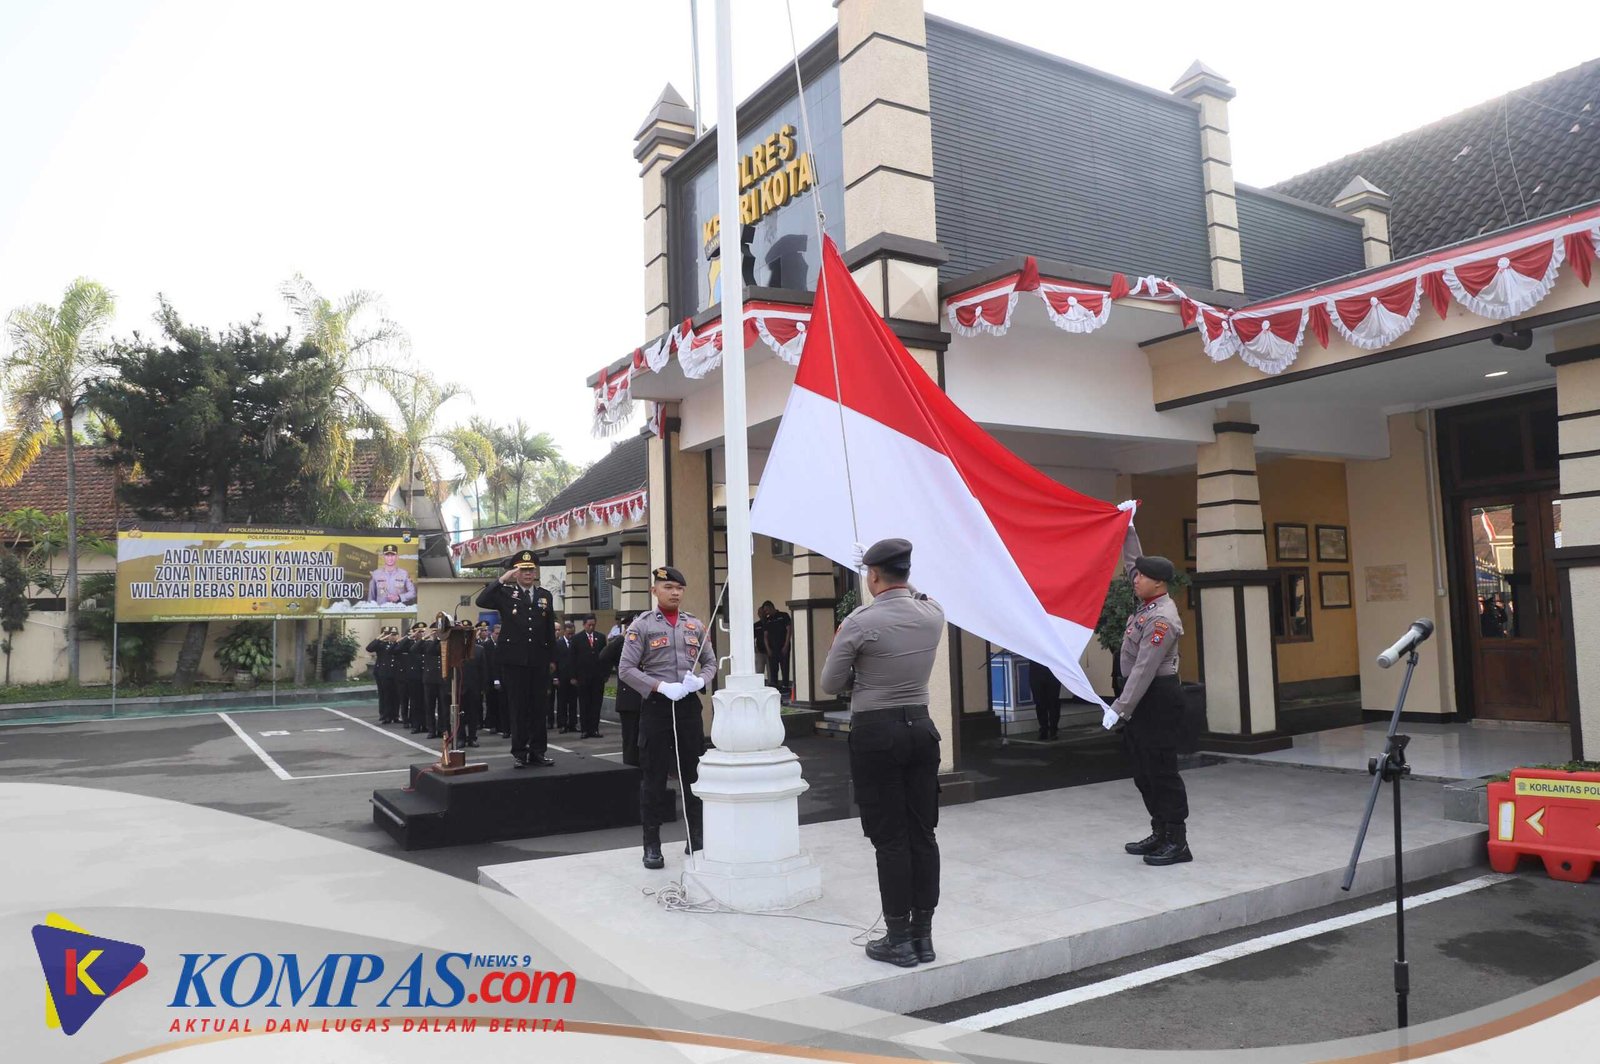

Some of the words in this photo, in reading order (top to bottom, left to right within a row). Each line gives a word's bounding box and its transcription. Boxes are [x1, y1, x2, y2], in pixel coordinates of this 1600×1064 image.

[738, 123, 797, 191] LRES
[761, 152, 813, 216] KOTA
[163, 549, 200, 564] ANDA
[203, 549, 271, 565] MEMASUKI
[274, 550, 334, 566] KAWASAN
[155, 565, 191, 581] ZONA
[194, 566, 267, 581] INTEGRITAS
[270, 566, 292, 582] (ZI)
[295, 567, 343, 582] MENUJU
[131, 583, 190, 598] WILAYAH
[193, 583, 235, 598] BEBAS
[238, 583, 267, 598] DARI
[271, 583, 322, 598] KORUPSI
[326, 583, 364, 599] (WBK)
[1529, 783, 1581, 794] KORLANTAS
